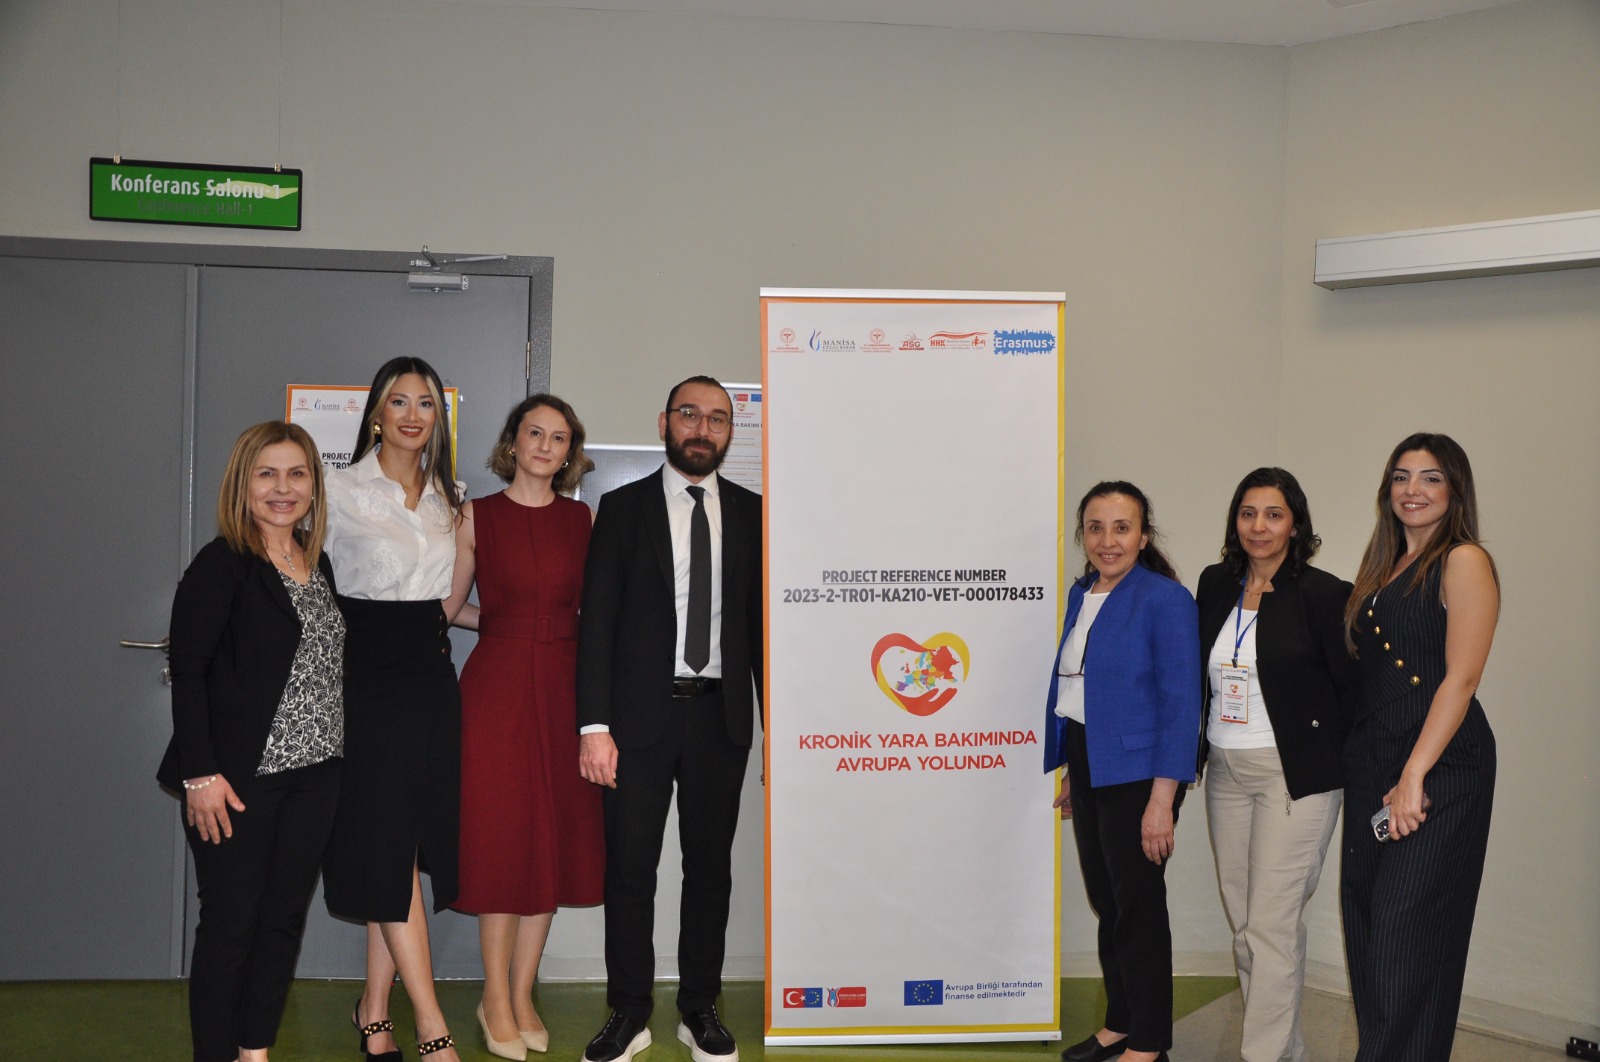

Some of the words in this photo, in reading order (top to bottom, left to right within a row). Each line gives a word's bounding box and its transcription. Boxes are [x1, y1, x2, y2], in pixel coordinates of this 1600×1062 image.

[111, 174, 200, 196] Konferans
[206, 178, 280, 199] Salonu-1
[216, 202, 253, 216] Hall-1
[930, 339, 946, 347] HHK
[994, 337, 1055, 349] Erasmus+
[321, 452, 352, 460] PROJECT
[822, 570, 878, 583] PROJECT
[880, 570, 952, 582] REFERENCE
[954, 569, 1007, 582] NUMBER
[783, 586, 1044, 603] 2023-2-TR01-KA210-VET-000178433
[799, 731, 872, 749] KRONİK
[878, 733, 929, 748] YARA
[934, 730, 1037, 747] BAKIMINDA
[836, 756, 911, 771] AVRUPA
[917, 754, 1006, 770] YOLUNDA
[945, 984, 974, 992] Avrupa
[976, 982, 1000, 990] Birliği
[945, 992, 975, 1000] finanse
[976, 991, 1026, 999] edilmektedir
